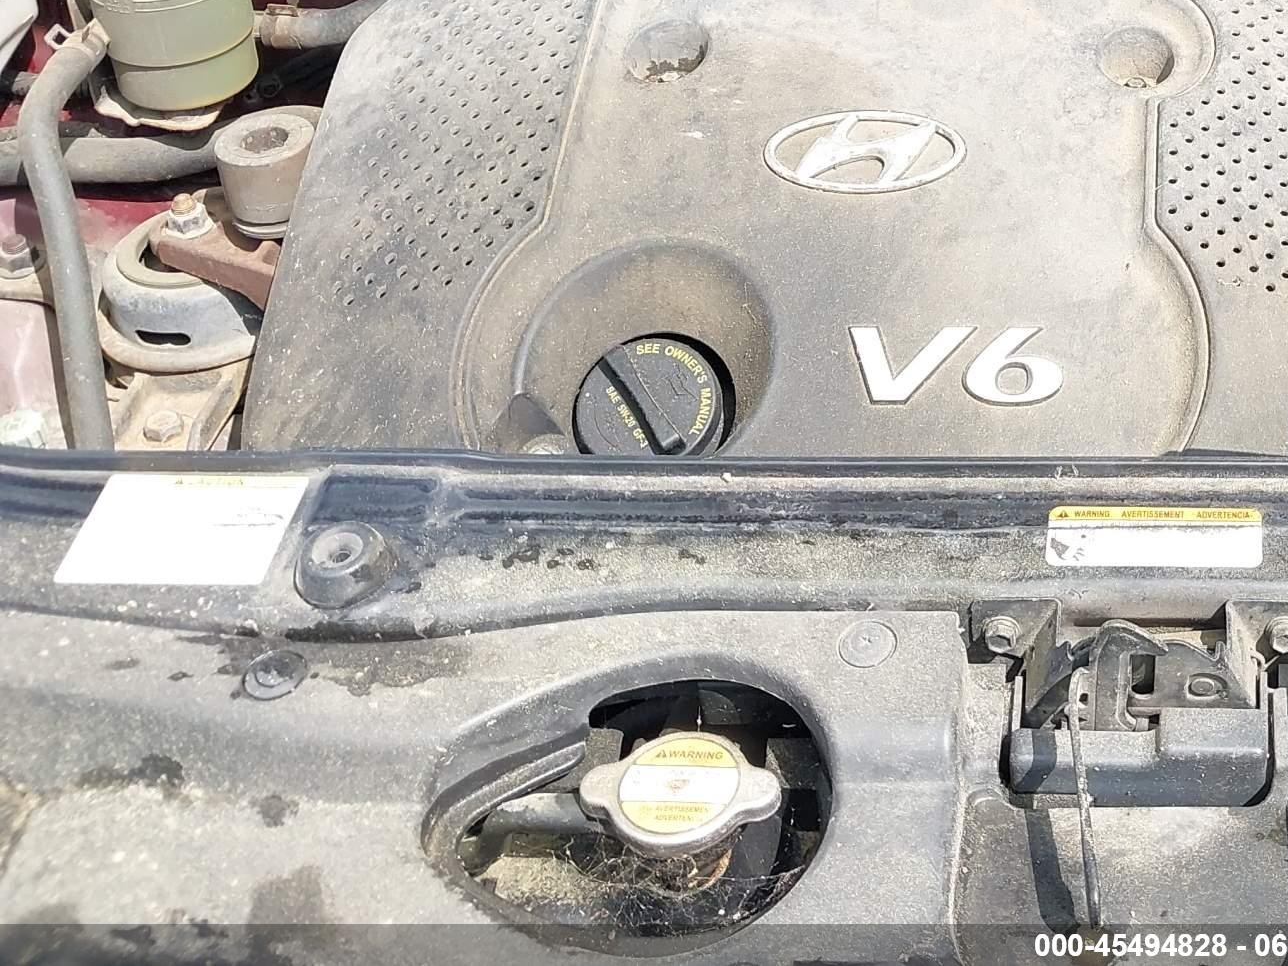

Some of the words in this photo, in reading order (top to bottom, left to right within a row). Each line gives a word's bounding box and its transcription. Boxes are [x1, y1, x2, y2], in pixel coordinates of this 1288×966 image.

[636, 343, 661, 355] SEE
[664, 345, 708, 384] OWNER'S
[688, 387, 714, 435] MANUAL
[848, 325, 1065, 407] V6
[1074, 510, 1111, 519] WARNING
[1121, 510, 1185, 519] AVERTISSEMENT
[1196, 511, 1251, 520] ADVERTENCIA
[668, 750, 724, 761] WARNING
